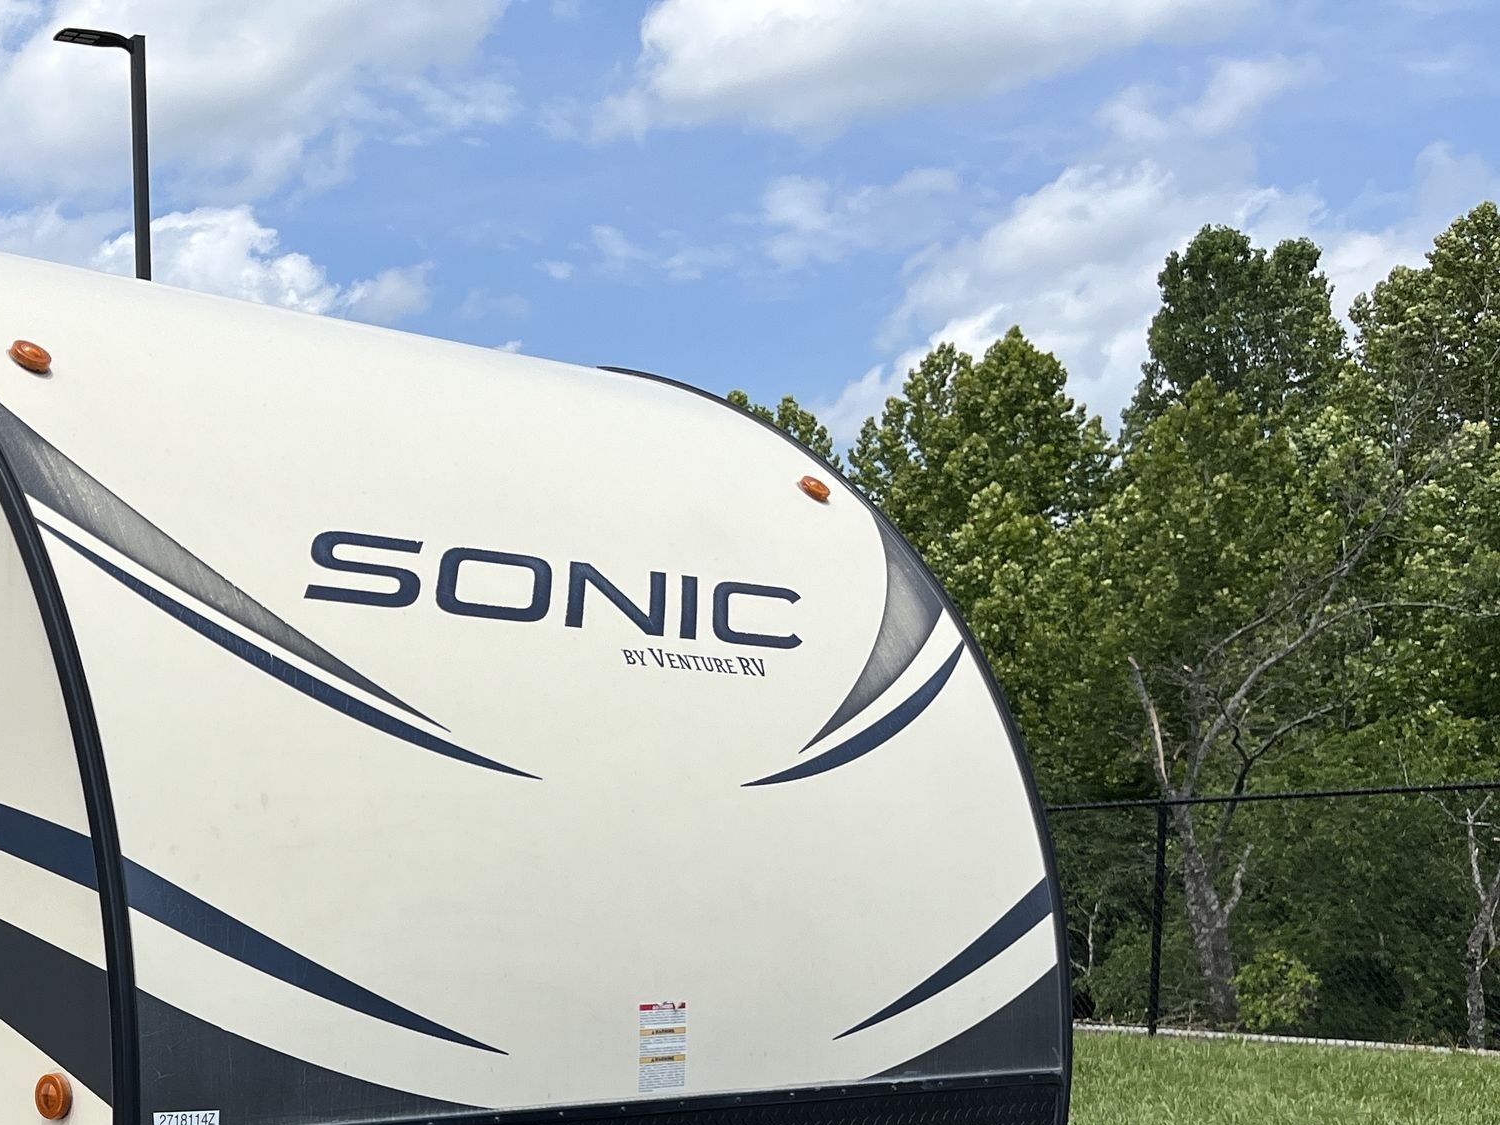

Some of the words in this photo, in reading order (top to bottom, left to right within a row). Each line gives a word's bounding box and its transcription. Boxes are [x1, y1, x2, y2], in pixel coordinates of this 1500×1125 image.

[303, 530, 804, 651] SONIC
[622, 648, 647, 666] BY
[736, 655, 766, 677] RV
